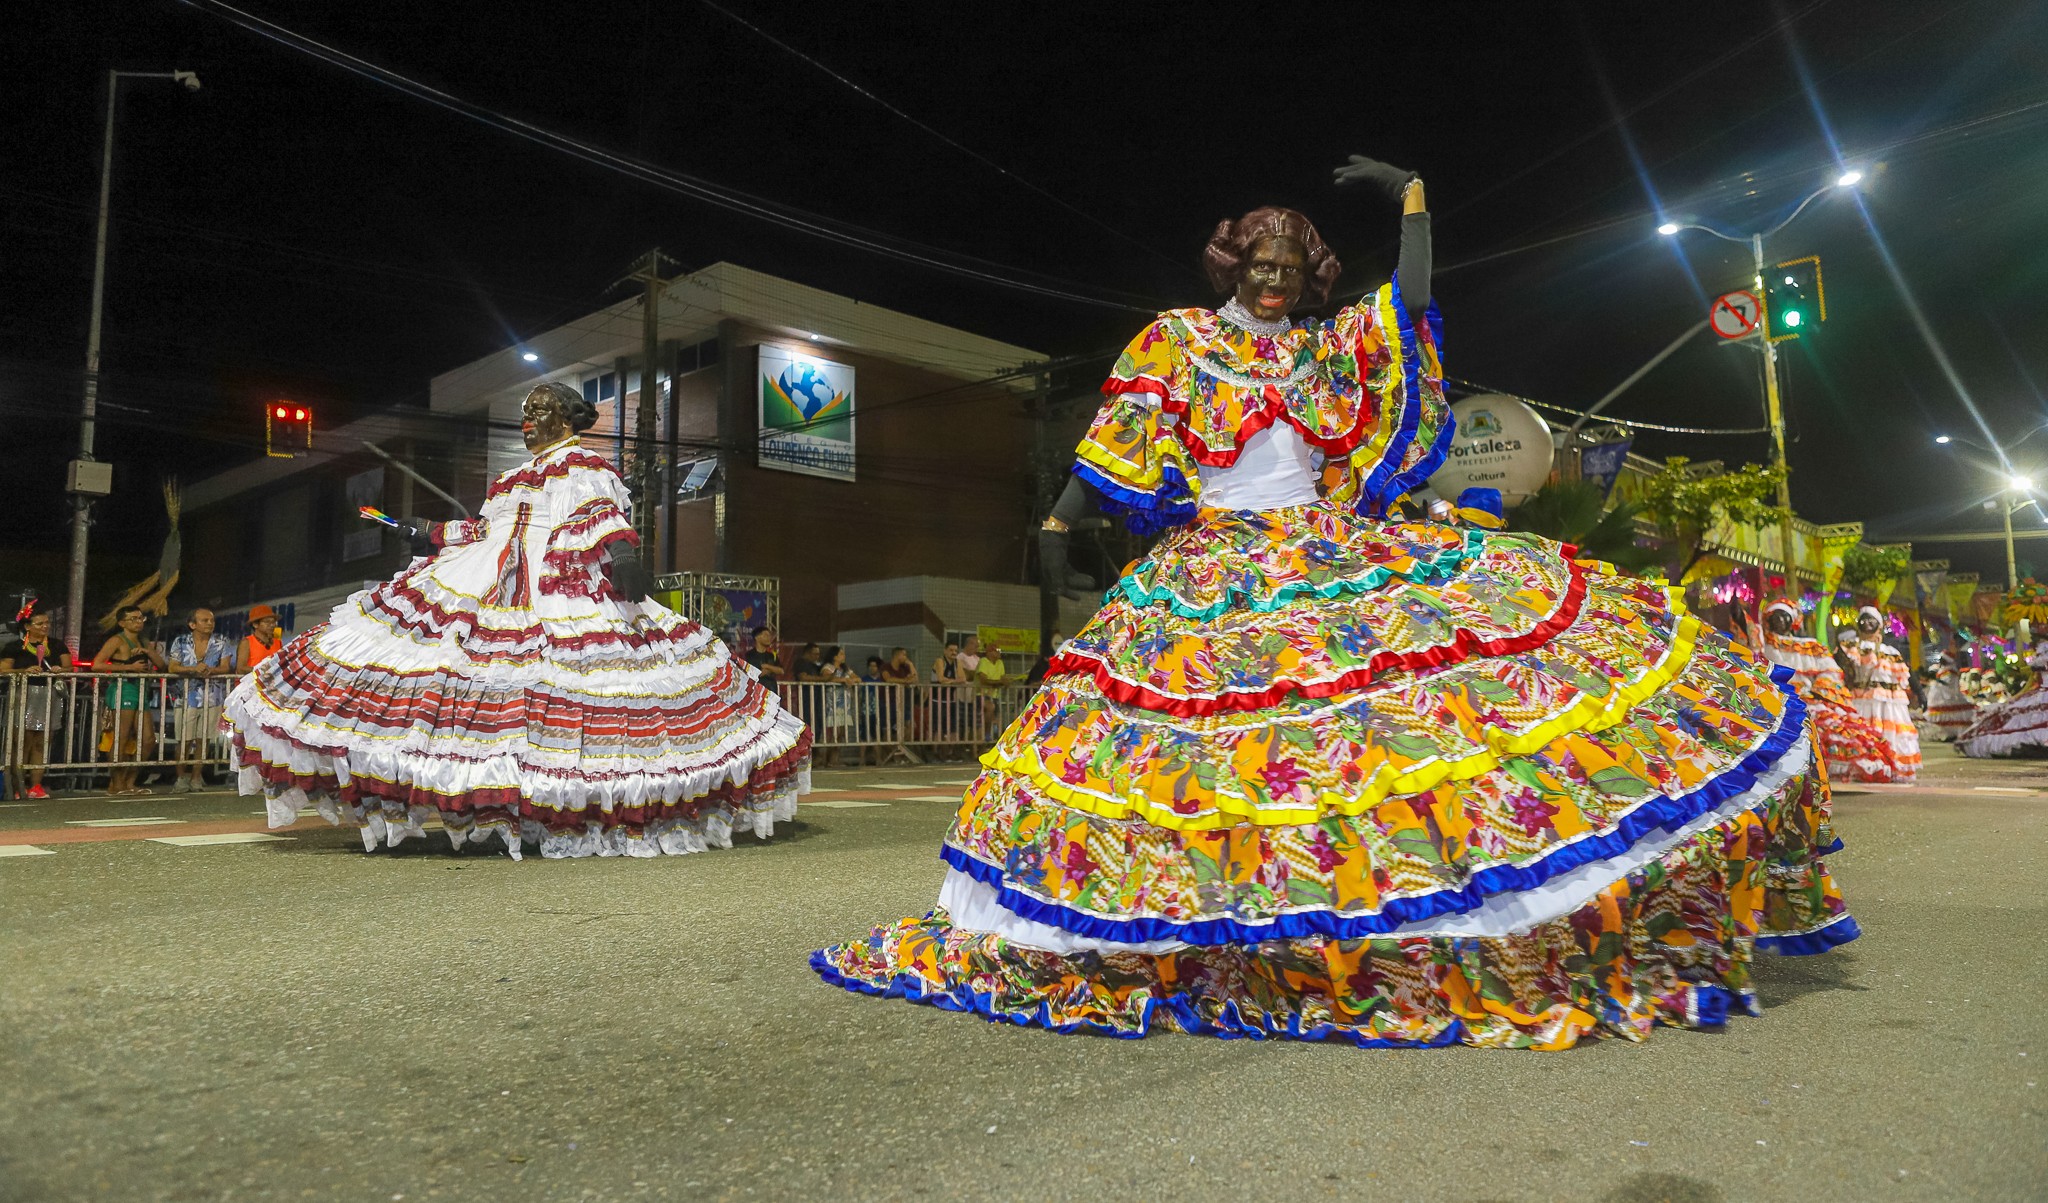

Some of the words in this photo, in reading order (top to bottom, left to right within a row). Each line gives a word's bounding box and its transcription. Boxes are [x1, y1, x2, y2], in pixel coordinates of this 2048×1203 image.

[1448, 439, 1522, 459] Fortaleza
[1457, 454, 1513, 466] PREFEITURA
[1467, 471, 1506, 482] Cultura
